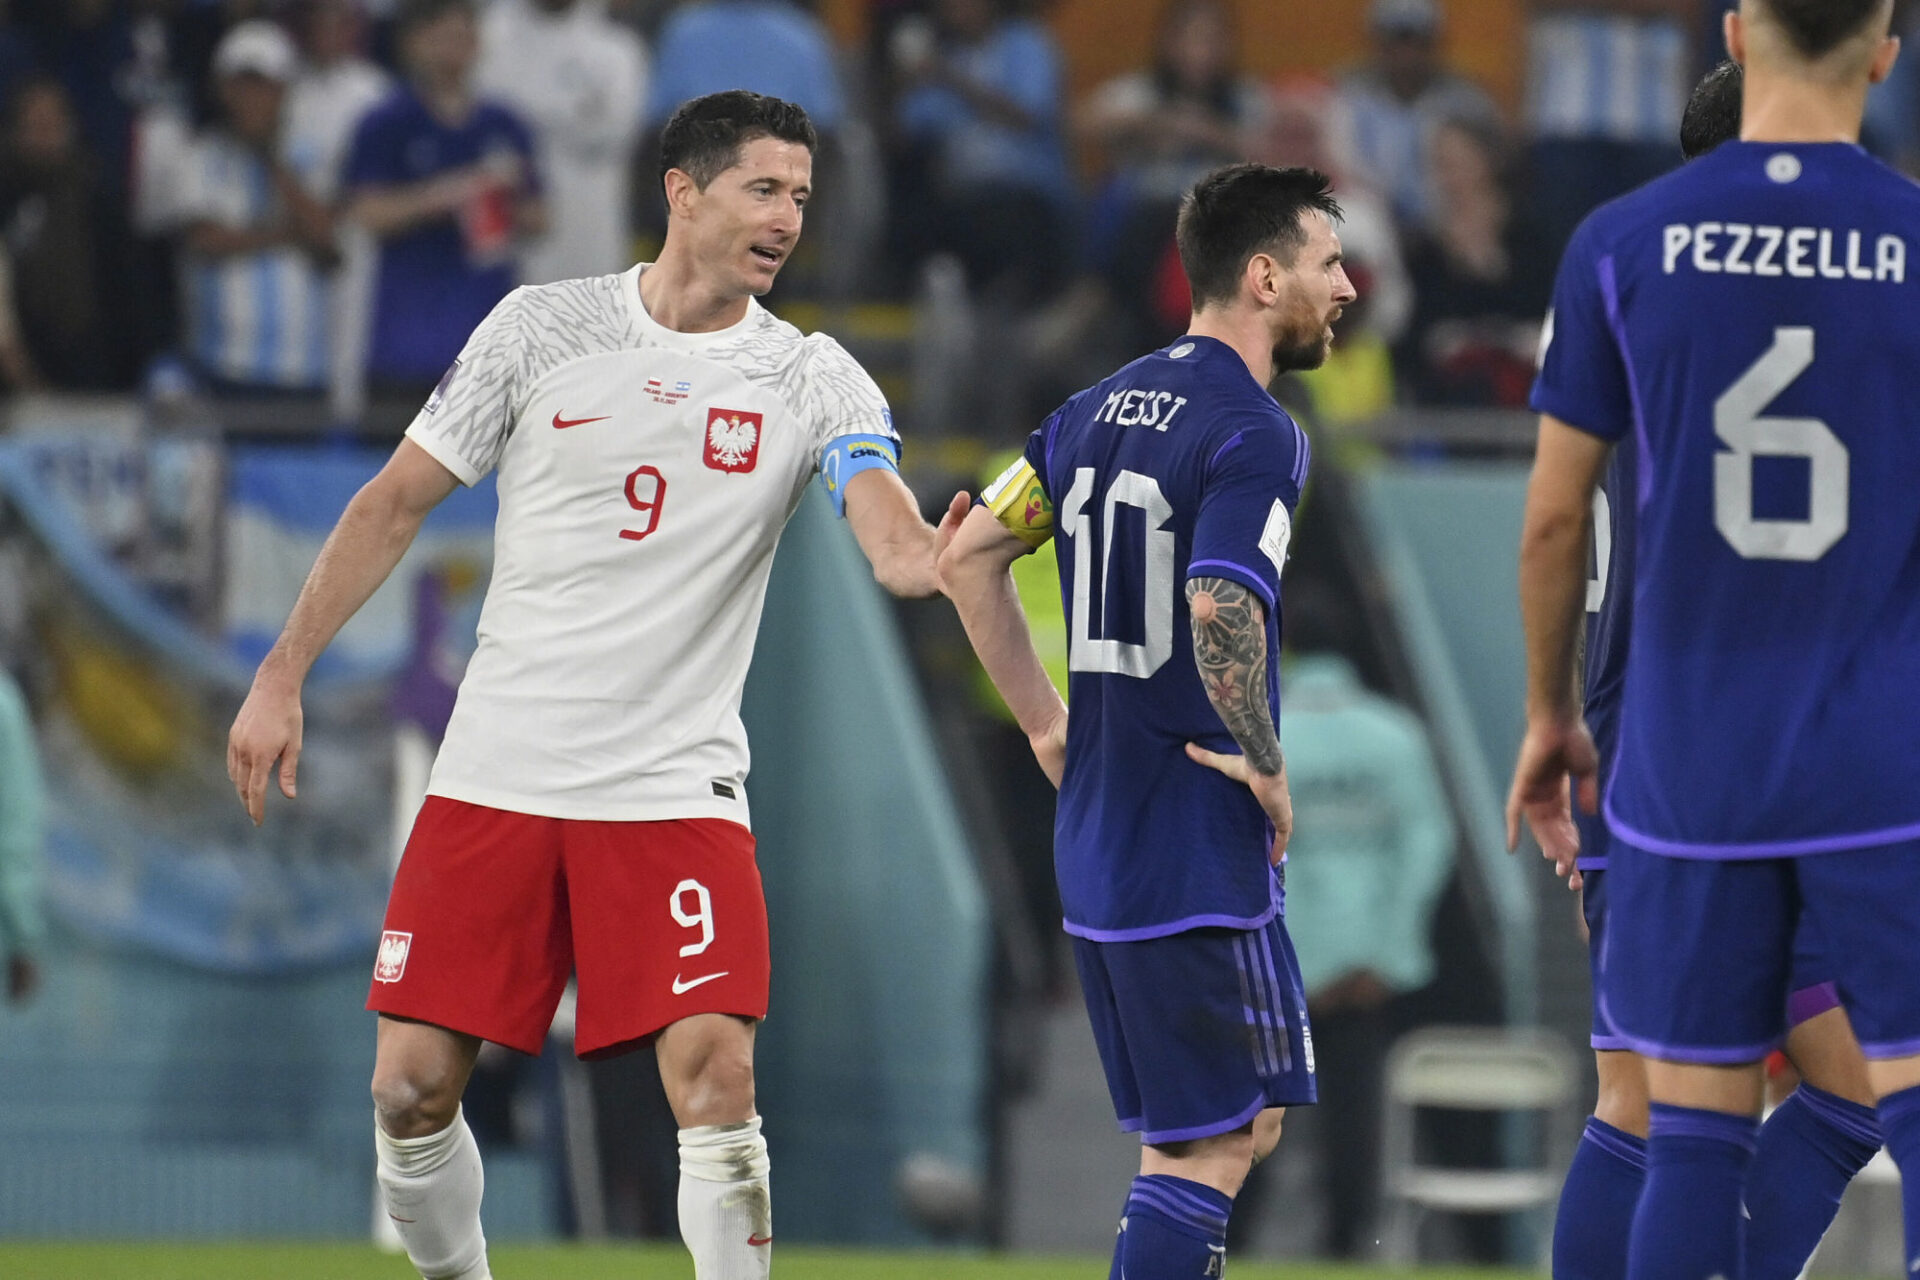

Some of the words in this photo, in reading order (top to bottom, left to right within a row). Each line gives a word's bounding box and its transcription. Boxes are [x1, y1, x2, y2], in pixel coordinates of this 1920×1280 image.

[1663, 222, 1906, 284] PEZZELLA
[1094, 388, 1188, 432] MESSI
[1713, 326, 1849, 562] 6
[618, 464, 667, 541] 9
[1061, 467, 1175, 679] 10
[669, 878, 715, 958] 9
